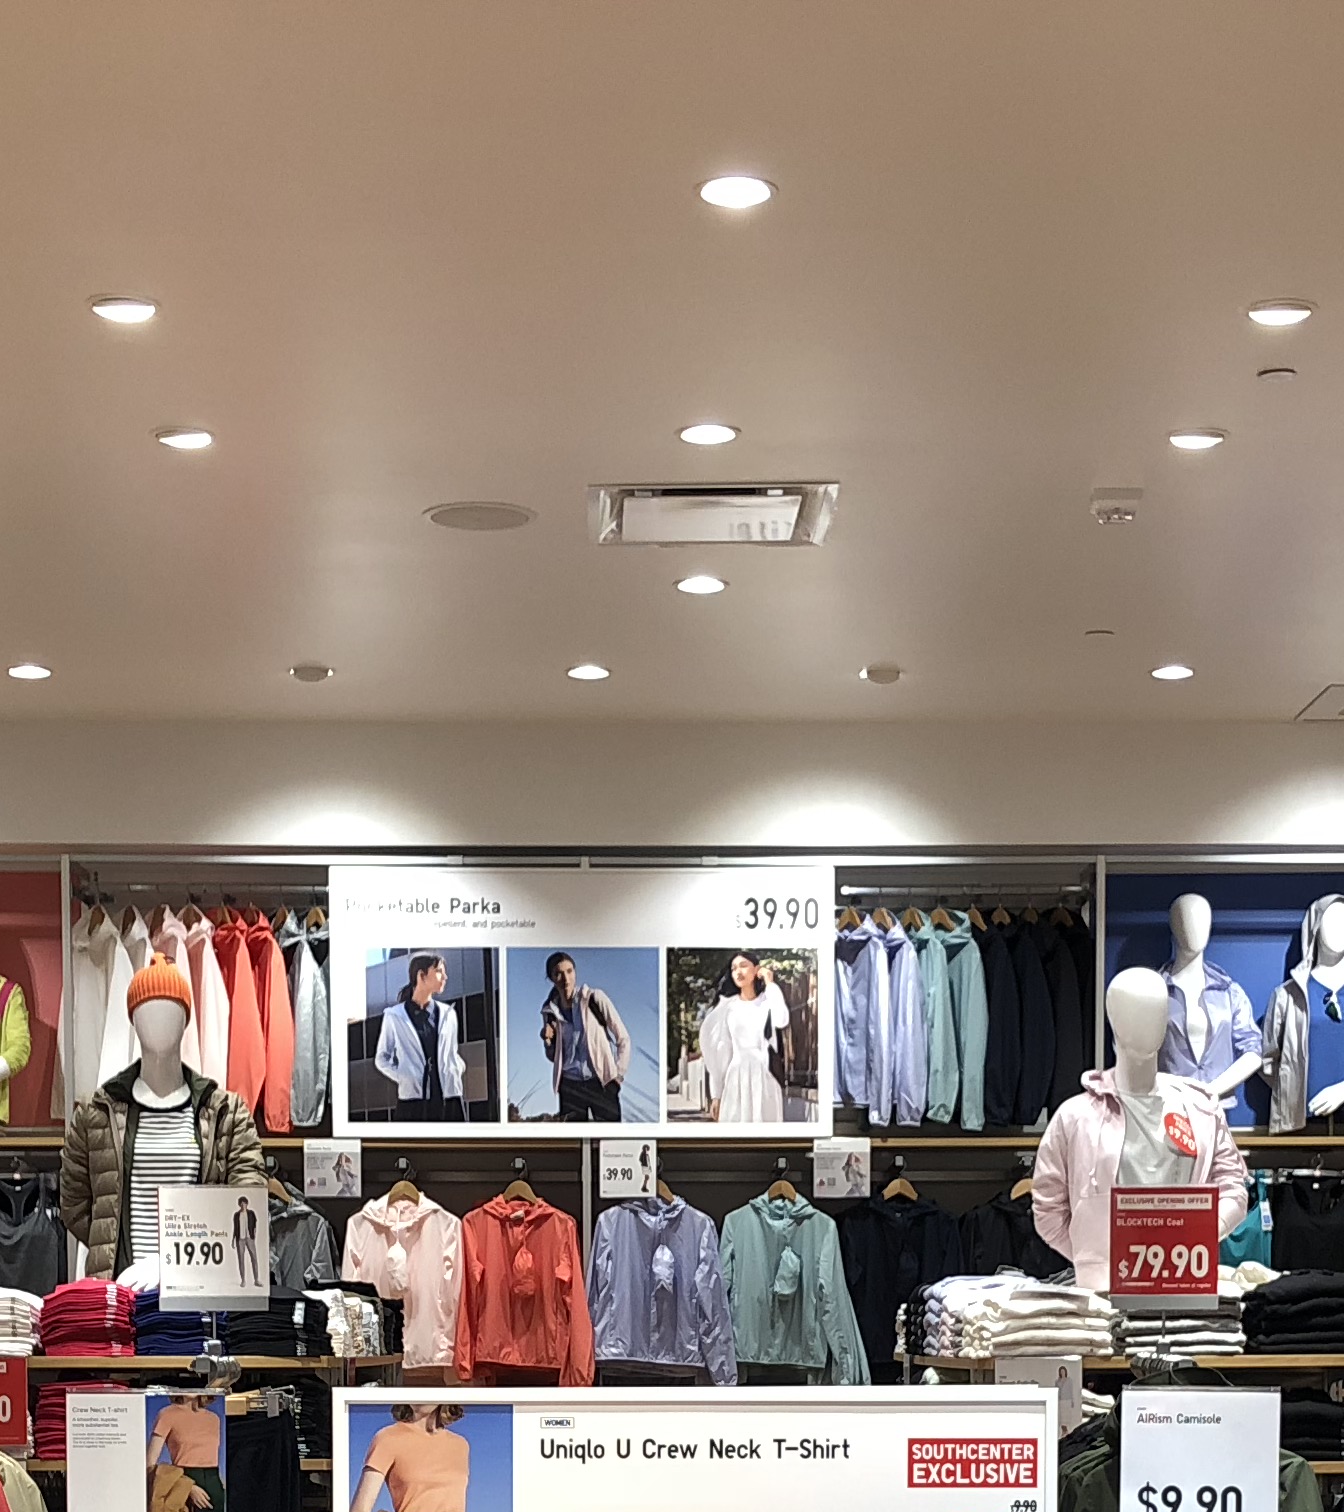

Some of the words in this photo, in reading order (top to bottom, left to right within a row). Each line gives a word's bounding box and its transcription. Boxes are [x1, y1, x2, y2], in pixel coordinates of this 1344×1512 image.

[450, 898, 501, 914] Parka
[735, 898, 820, 930] $39.90
[491, 919, 536, 929] pocketable
[1116, 1218, 1164, 1226] BLOCKTECH
[1167, 1218, 1184, 1226] Coat
[166, 1241, 224, 1265] $19.90
[1118, 1244, 1209, 1279] $79.90
[544, 1419, 571, 1427] WOMEN
[1137, 1413, 1172, 1424] AIRism
[1177, 1413, 1222, 1424] Camisole
[540, 1438, 605, 1464] Uniqlo
[616, 1438, 631, 1459] U
[642, 1438, 698, 1459] Crew
[709, 1438, 762, 1459] Neck
[773, 1438, 851, 1459] T-Shirt
[912, 1444, 1034, 1460] SOUTHCENTER
[913, 1463, 1034, 1484] EXCLUSIVE
